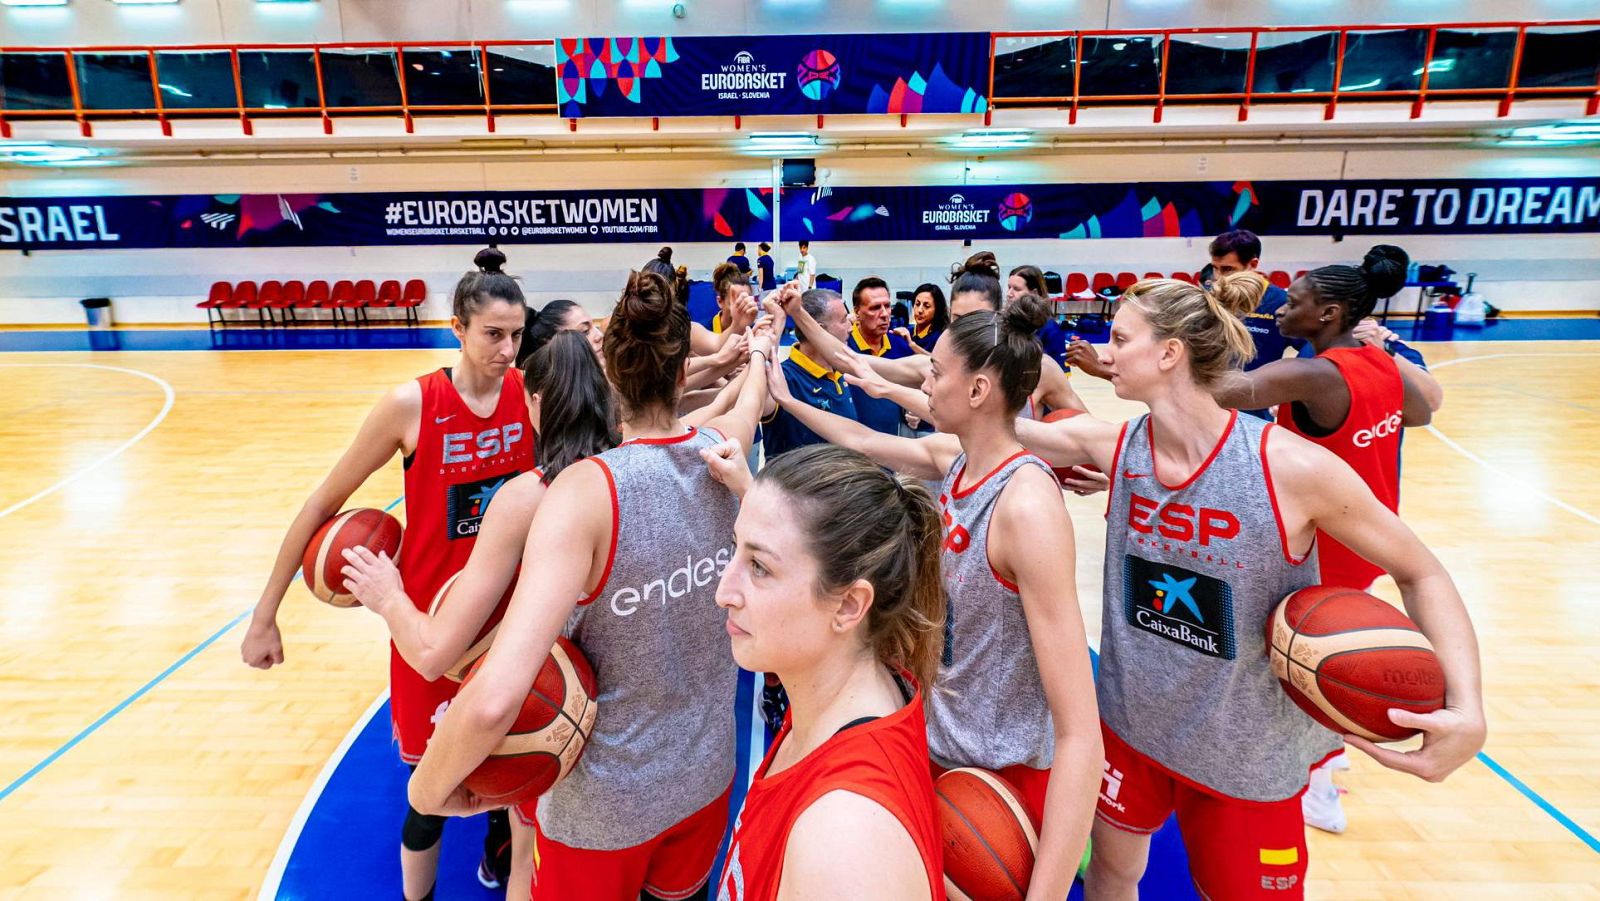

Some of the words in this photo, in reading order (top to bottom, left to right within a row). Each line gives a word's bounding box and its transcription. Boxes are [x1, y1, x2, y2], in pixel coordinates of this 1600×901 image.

[720, 64, 767, 73] WOMEN'S
[701, 72, 786, 90] EUROBASKET
[742, 91, 770, 99] SLOVENIA
[384, 198, 658, 225] #EUROBASKETWOMEN
[922, 209, 990, 224] EUROBASKET
[1296, 189, 1404, 226] DARE
[1411, 189, 1461, 225] TO
[521, 226, 588, 236] @EUROBASKETWOMEN
[601, 225, 659, 234] YOUTUBE.COM/FIBA
[442, 421, 524, 465] ESP
[1127, 491, 1241, 547] ESP
[610, 547, 735, 616] endes
[1135, 609, 1220, 654] CaixaBank
[1260, 874, 1299, 891] ESP
